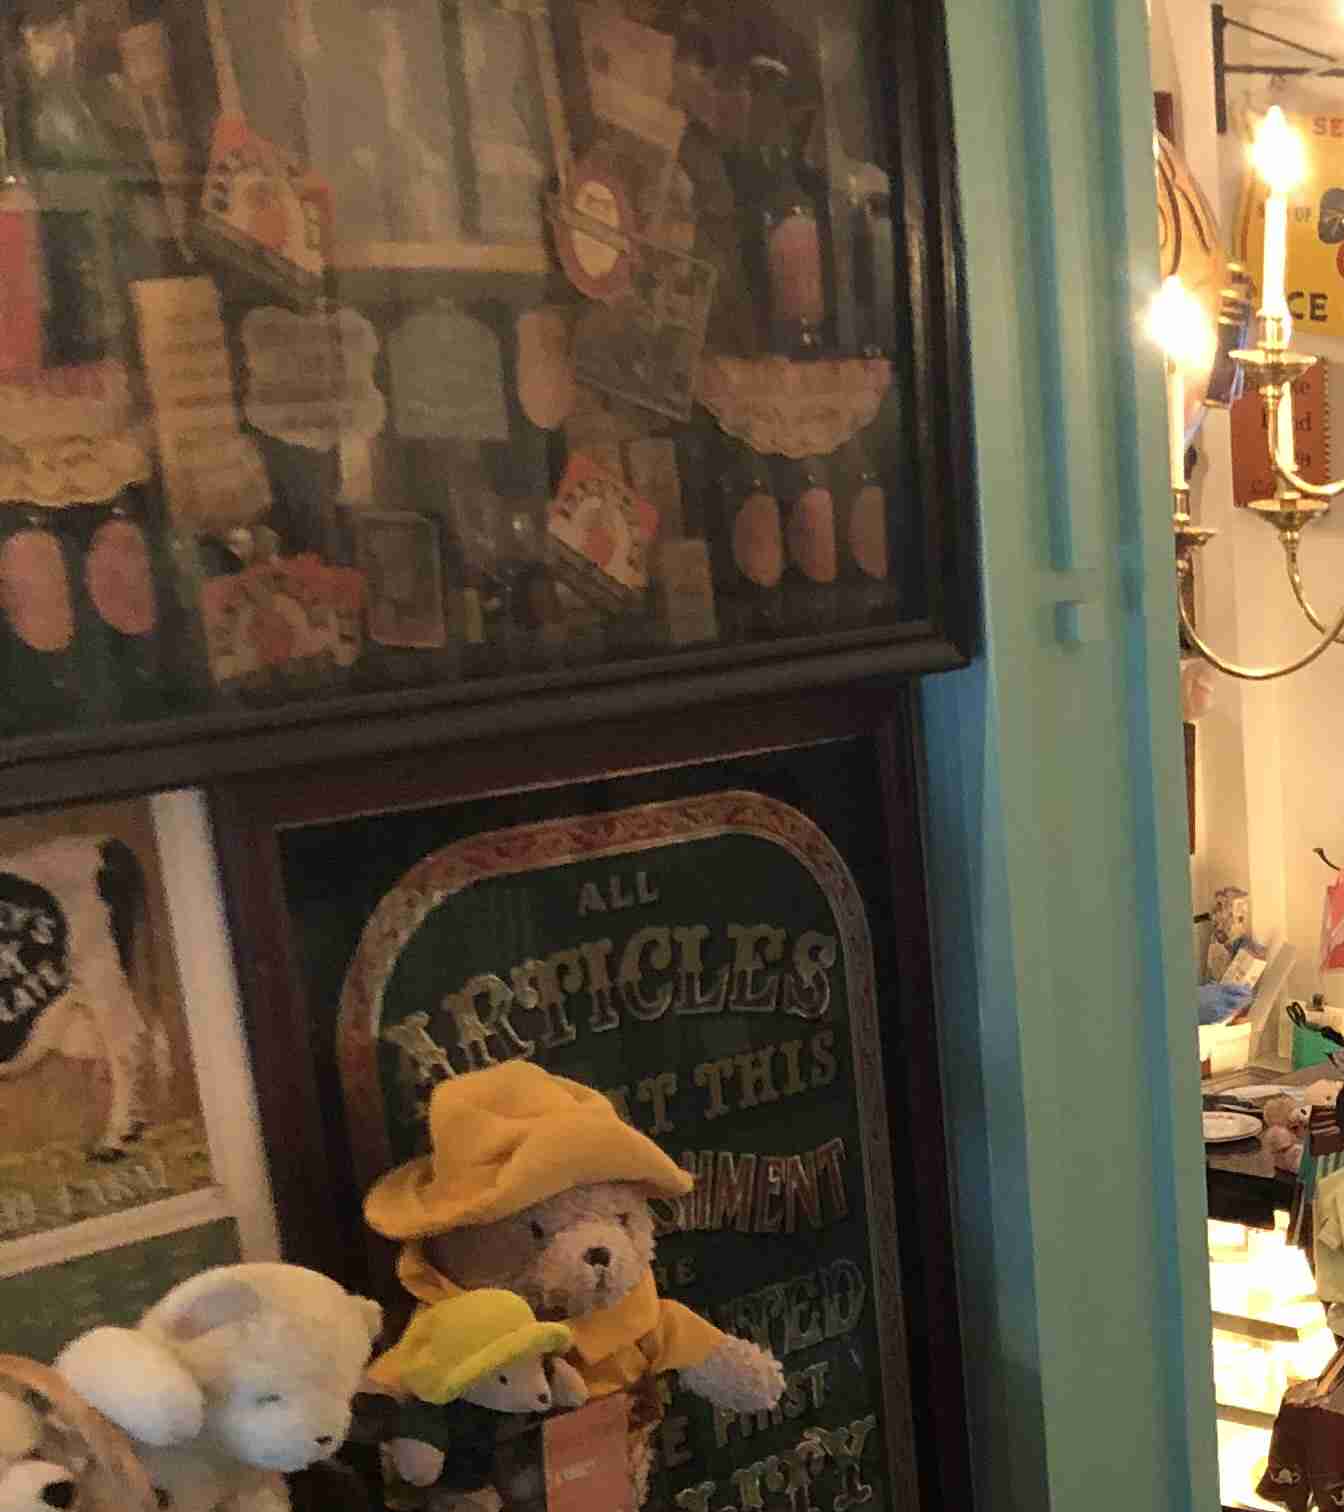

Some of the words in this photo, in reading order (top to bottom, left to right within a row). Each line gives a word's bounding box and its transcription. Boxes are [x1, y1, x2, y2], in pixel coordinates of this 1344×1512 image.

[575, 870, 662, 918] ALL
[384, 921, 838, 1079] ARTICLES
[694, 1029, 842, 1121] THIS
